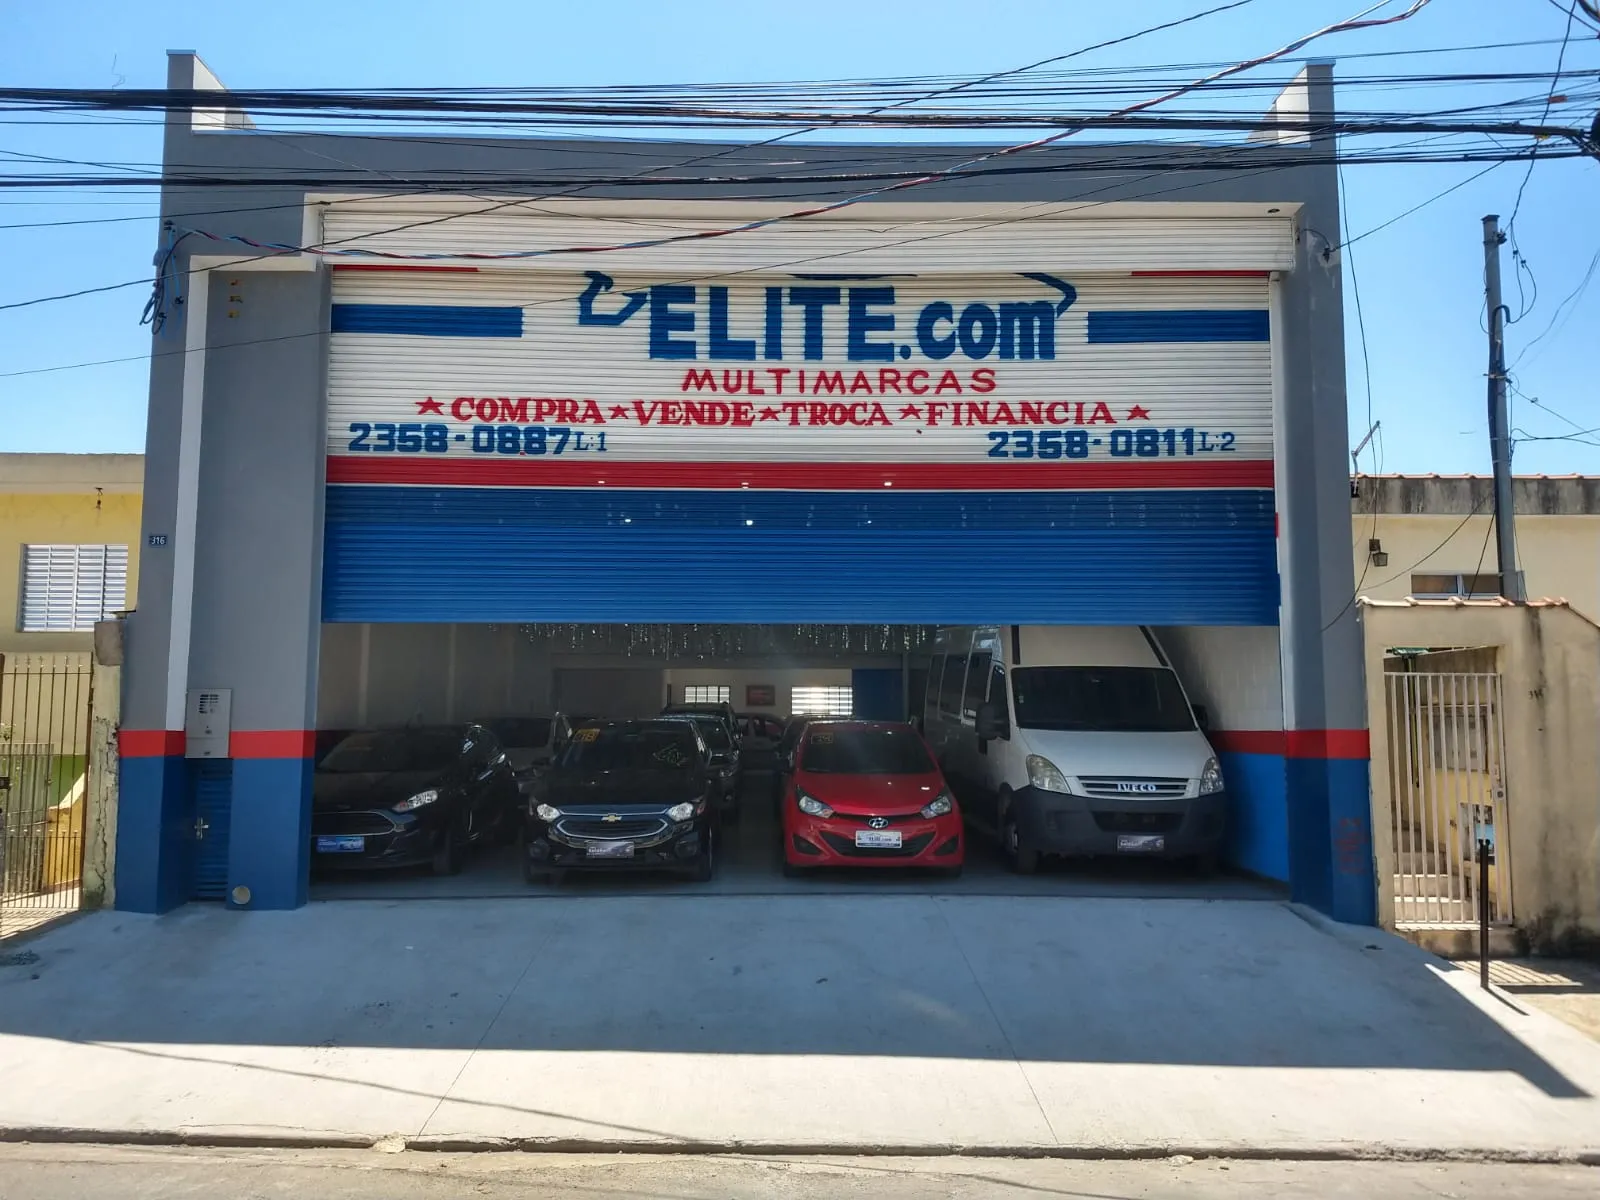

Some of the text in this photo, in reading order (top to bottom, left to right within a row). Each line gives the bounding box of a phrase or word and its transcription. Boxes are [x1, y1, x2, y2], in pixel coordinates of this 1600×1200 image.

[649, 284, 1056, 361] ELITE.com
[681, 368, 997, 395] MULTIMARCAS
[451, 397, 1118, 427] COMPRA VENDE TROCA FINANCIA
[348, 423, 571, 455] 2358-0887
[987, 428, 1195, 459] 2358-0811
[1116, 783, 1157, 793] IVECO
